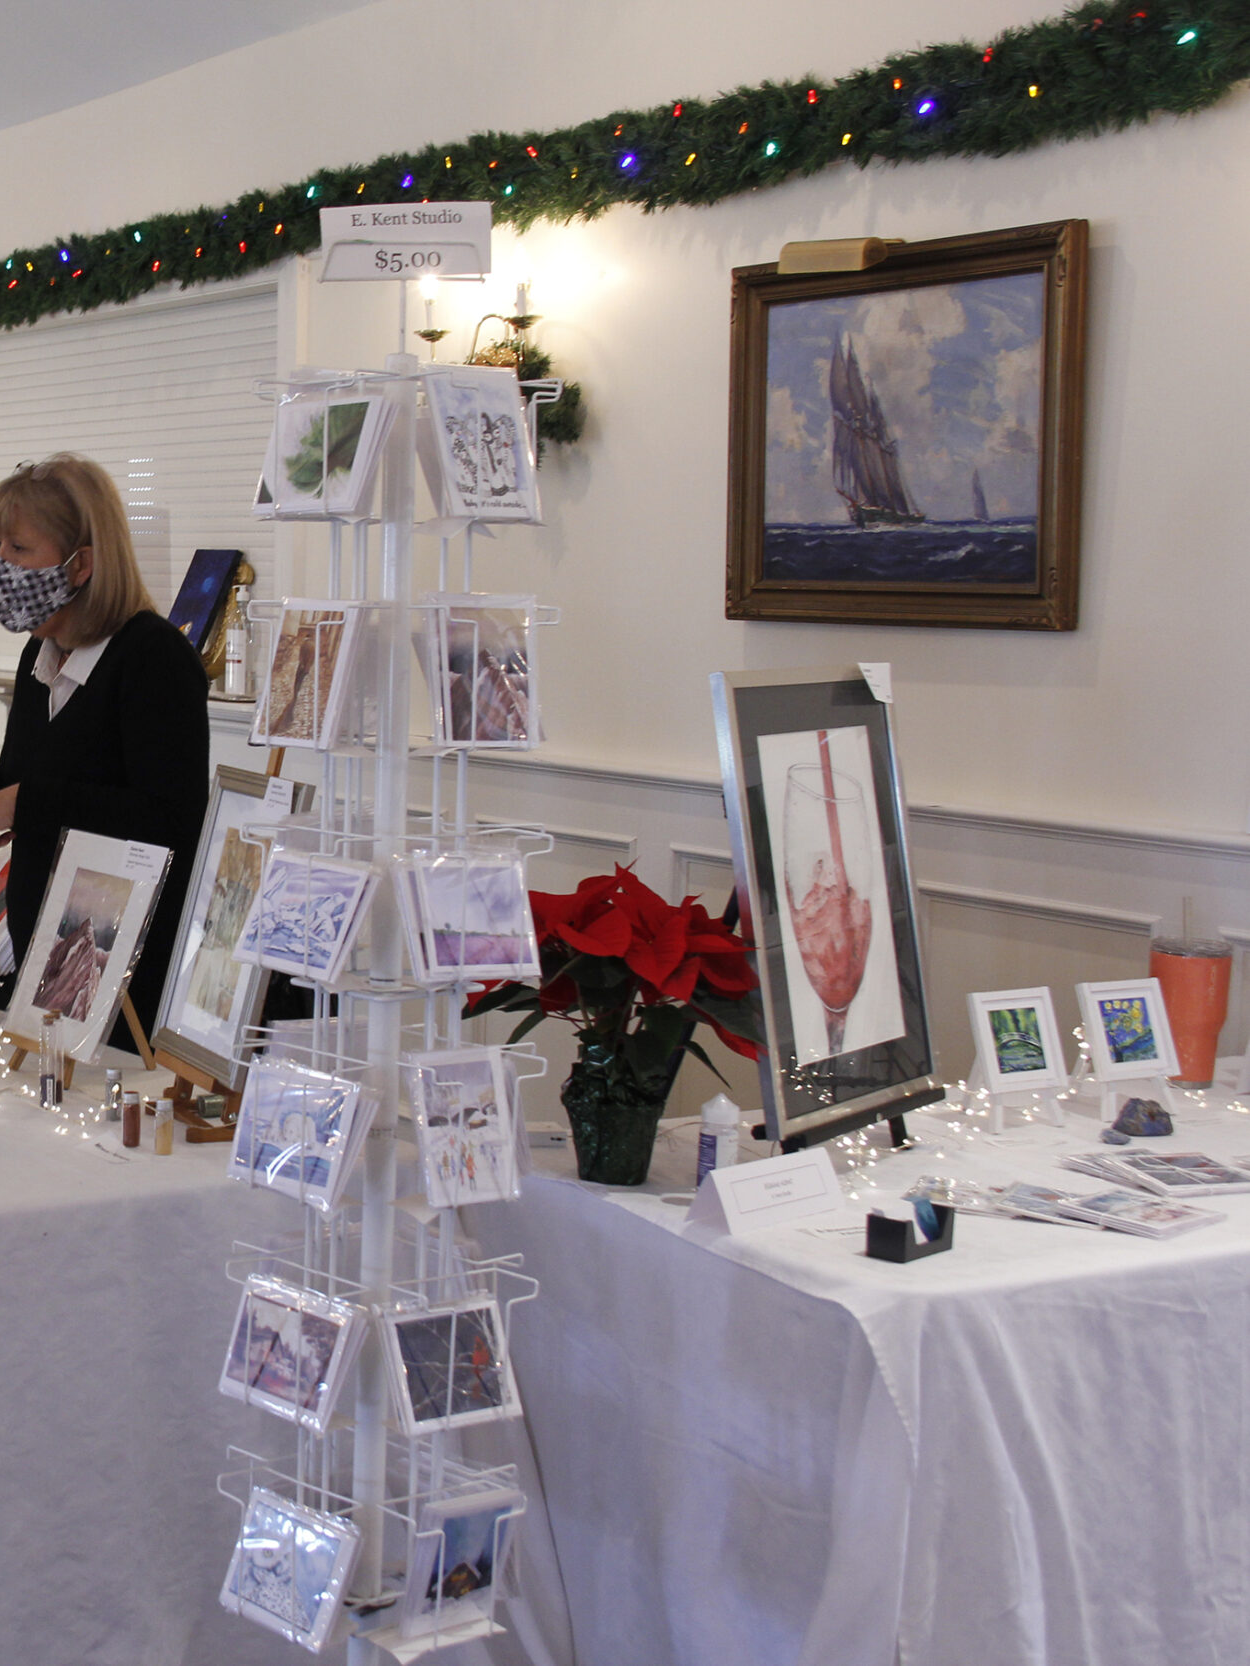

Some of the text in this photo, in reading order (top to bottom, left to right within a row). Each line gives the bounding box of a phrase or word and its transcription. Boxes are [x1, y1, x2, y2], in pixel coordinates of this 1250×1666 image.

[351, 209, 462, 227] E. Kent Studio
[375, 249, 441, 272] $5.00
